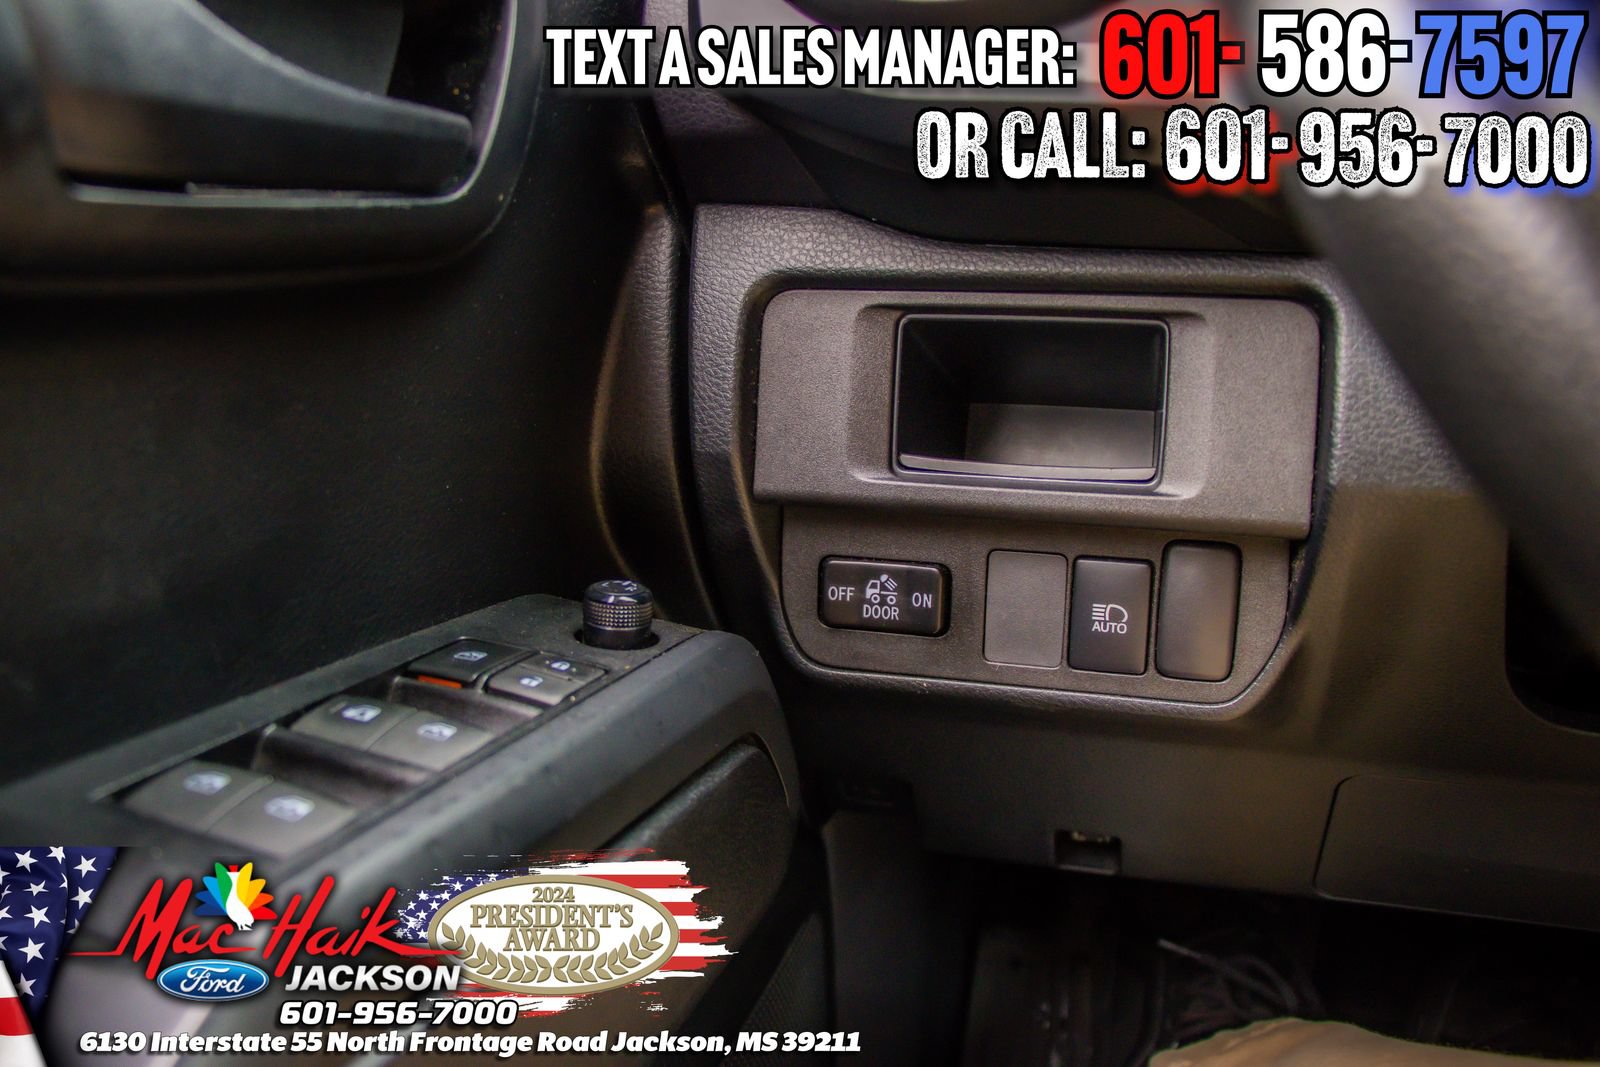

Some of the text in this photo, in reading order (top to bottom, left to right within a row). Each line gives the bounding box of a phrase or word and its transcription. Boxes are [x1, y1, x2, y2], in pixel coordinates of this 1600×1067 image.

[827, 586, 855, 601] OFF
[911, 592, 932, 608] ON
[862, 604, 899, 621] DOOR
[1091, 621, 1127, 634] AUTO
